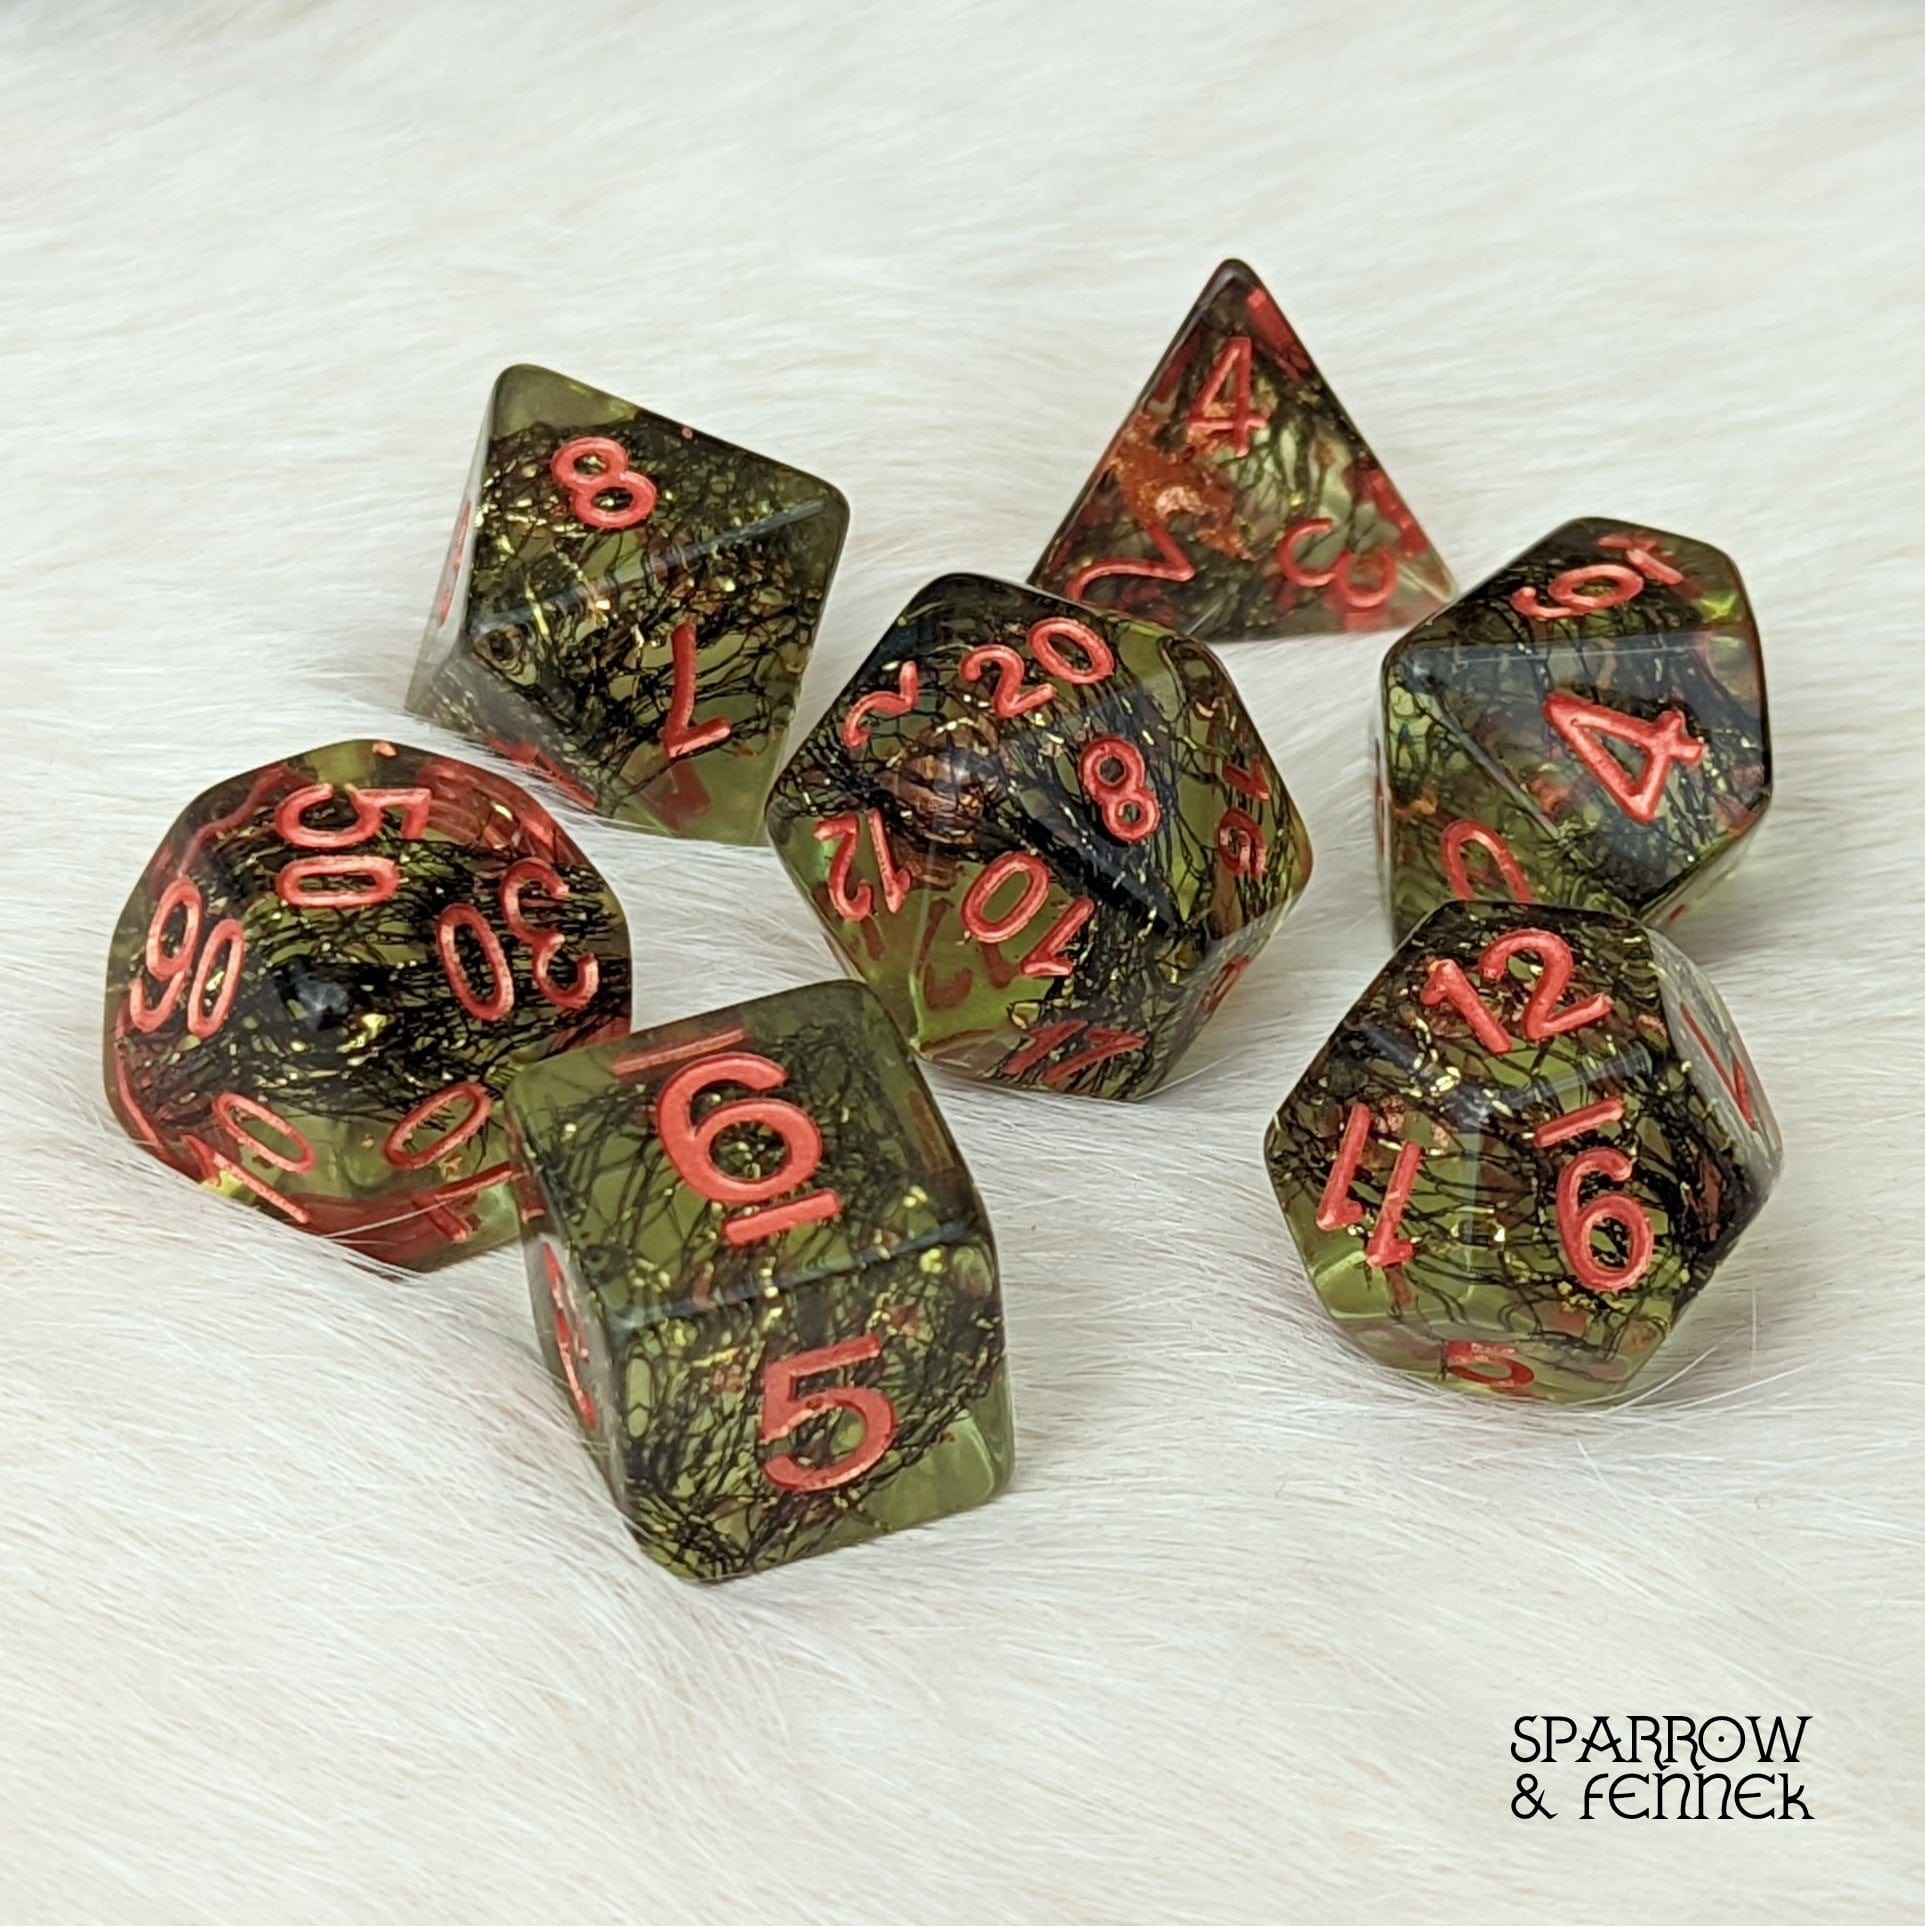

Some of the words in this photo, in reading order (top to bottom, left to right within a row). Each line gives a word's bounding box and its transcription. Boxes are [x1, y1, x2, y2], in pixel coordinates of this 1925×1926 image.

[1188, 336, 1270, 458] 4
[550, 436, 658, 530] 8
[1277, 517, 1399, 607] 3
[842, 660, 920, 748] 2
[960, 616, 1115, 719] 20
[1078, 735, 1161, 844] 8
[1543, 692, 1708, 825] 4
[275, 783, 432, 909] 50
[814, 807, 912, 922] 12
[129, 875, 246, 1040] 90
[437, 857, 599, 1022] 30
[961, 851, 1095, 979] 10
[1420, 927, 1614, 1056] 12
[655, 1052, 843, 1249] 6
[1315, 1101, 1424, 1269] 11
[759, 1333, 897, 1494] 5
